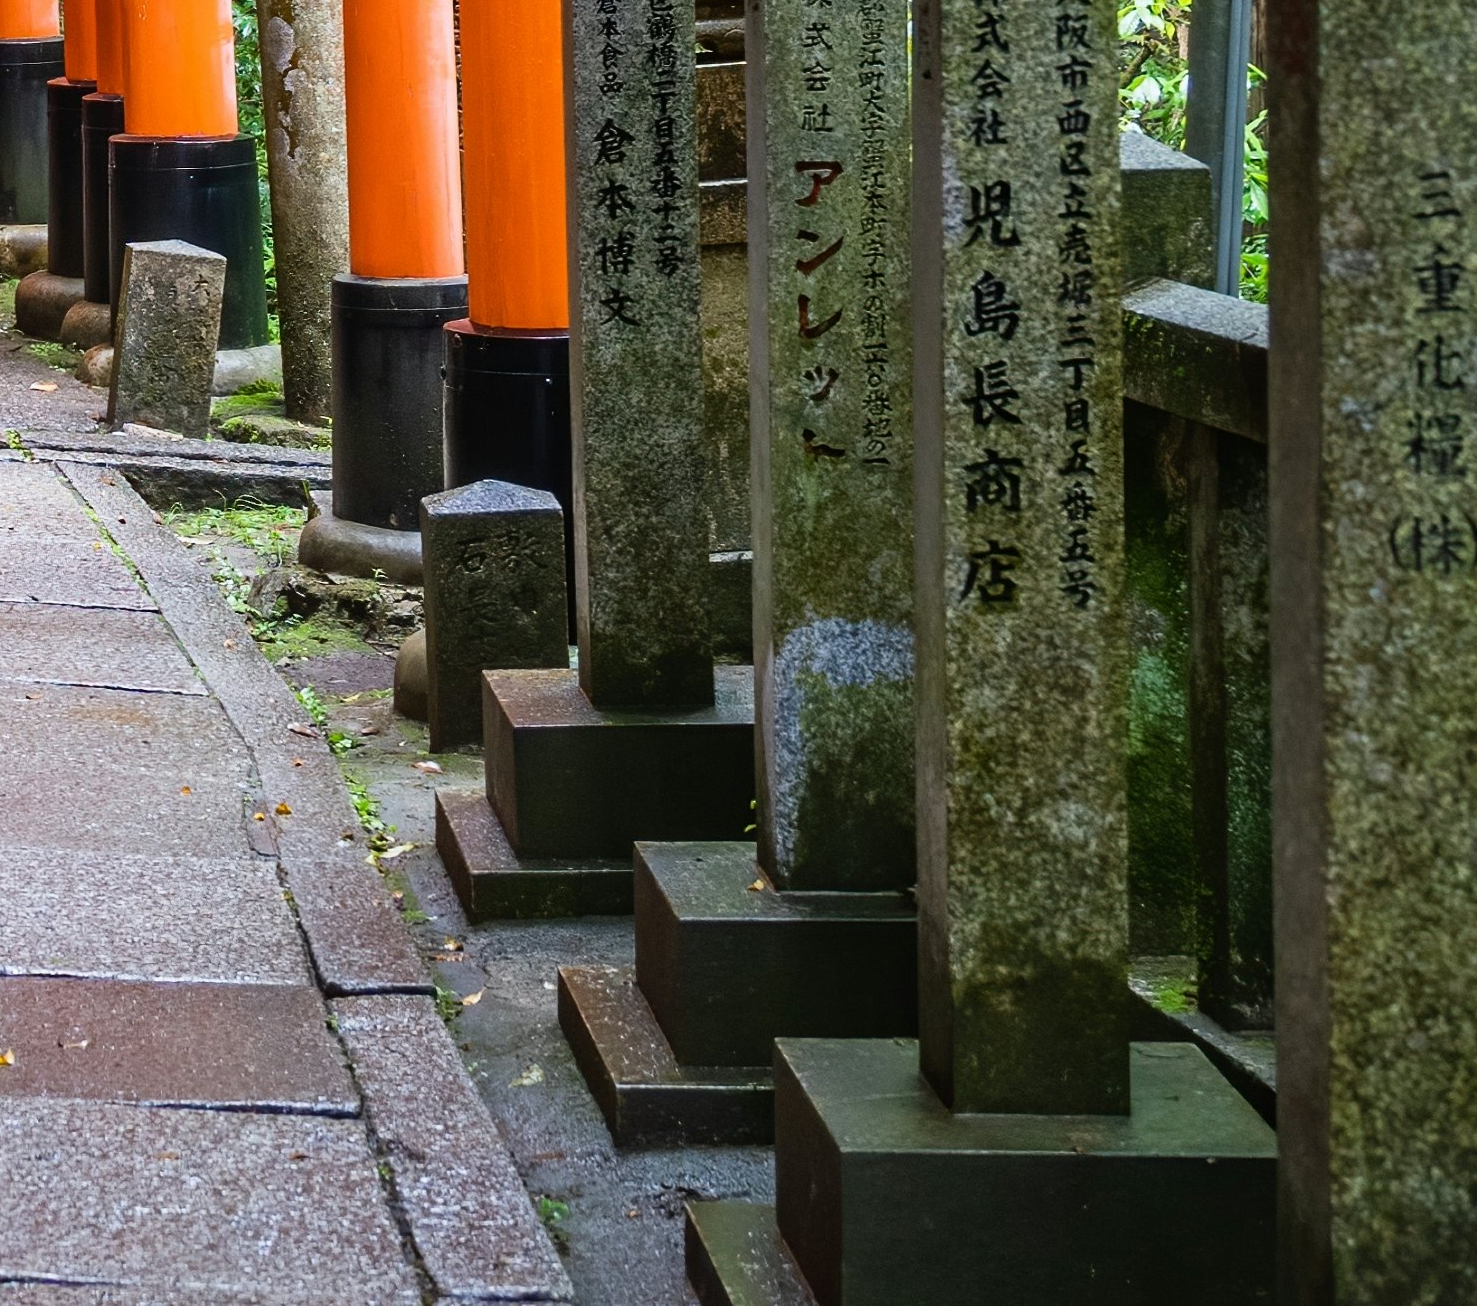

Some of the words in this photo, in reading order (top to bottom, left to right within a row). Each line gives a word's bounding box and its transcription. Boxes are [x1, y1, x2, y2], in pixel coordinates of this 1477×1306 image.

[593, 117, 641, 327] 倉本博文
[794, 159, 847, 458] アンレット
[958, 179, 1024, 604] 児島長商店
